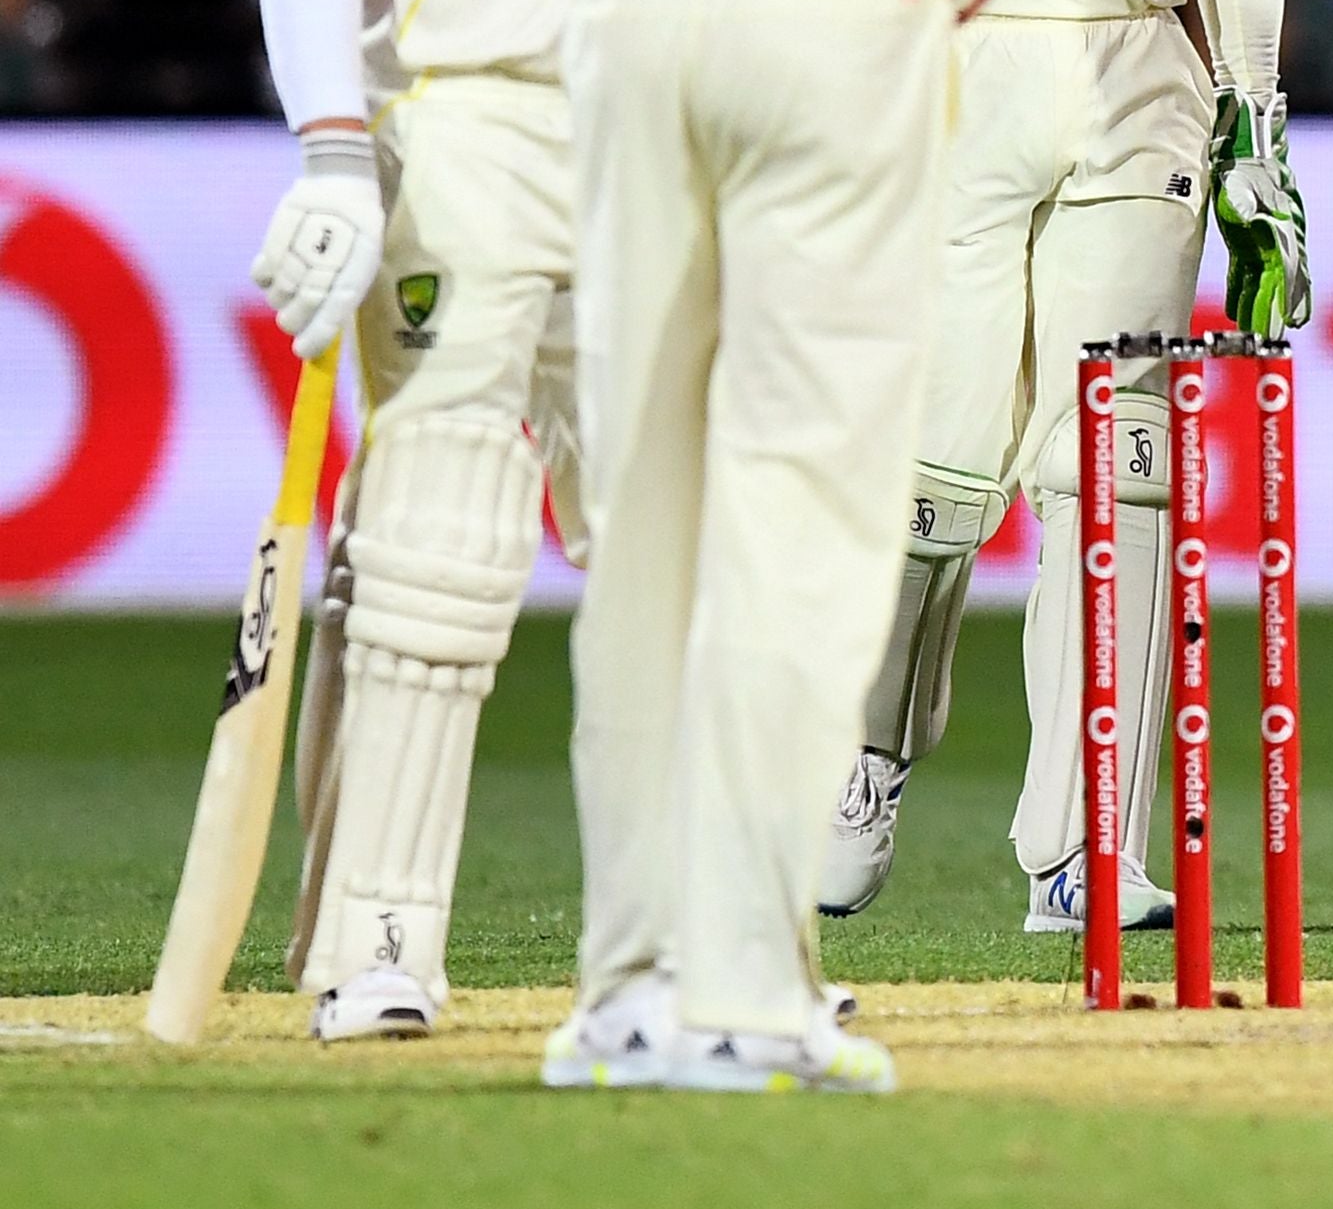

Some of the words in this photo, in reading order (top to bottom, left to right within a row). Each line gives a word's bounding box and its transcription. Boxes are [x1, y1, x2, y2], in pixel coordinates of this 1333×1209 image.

[1095, 419, 1113, 526] vodafone
[1182, 416, 1204, 523] vodafone
[1264, 416, 1284, 523] vodafone
[1183, 580, 1205, 688] vodfone
[1265, 580, 1287, 688] vodafone
[1268, 746, 1290, 854] vodafone
